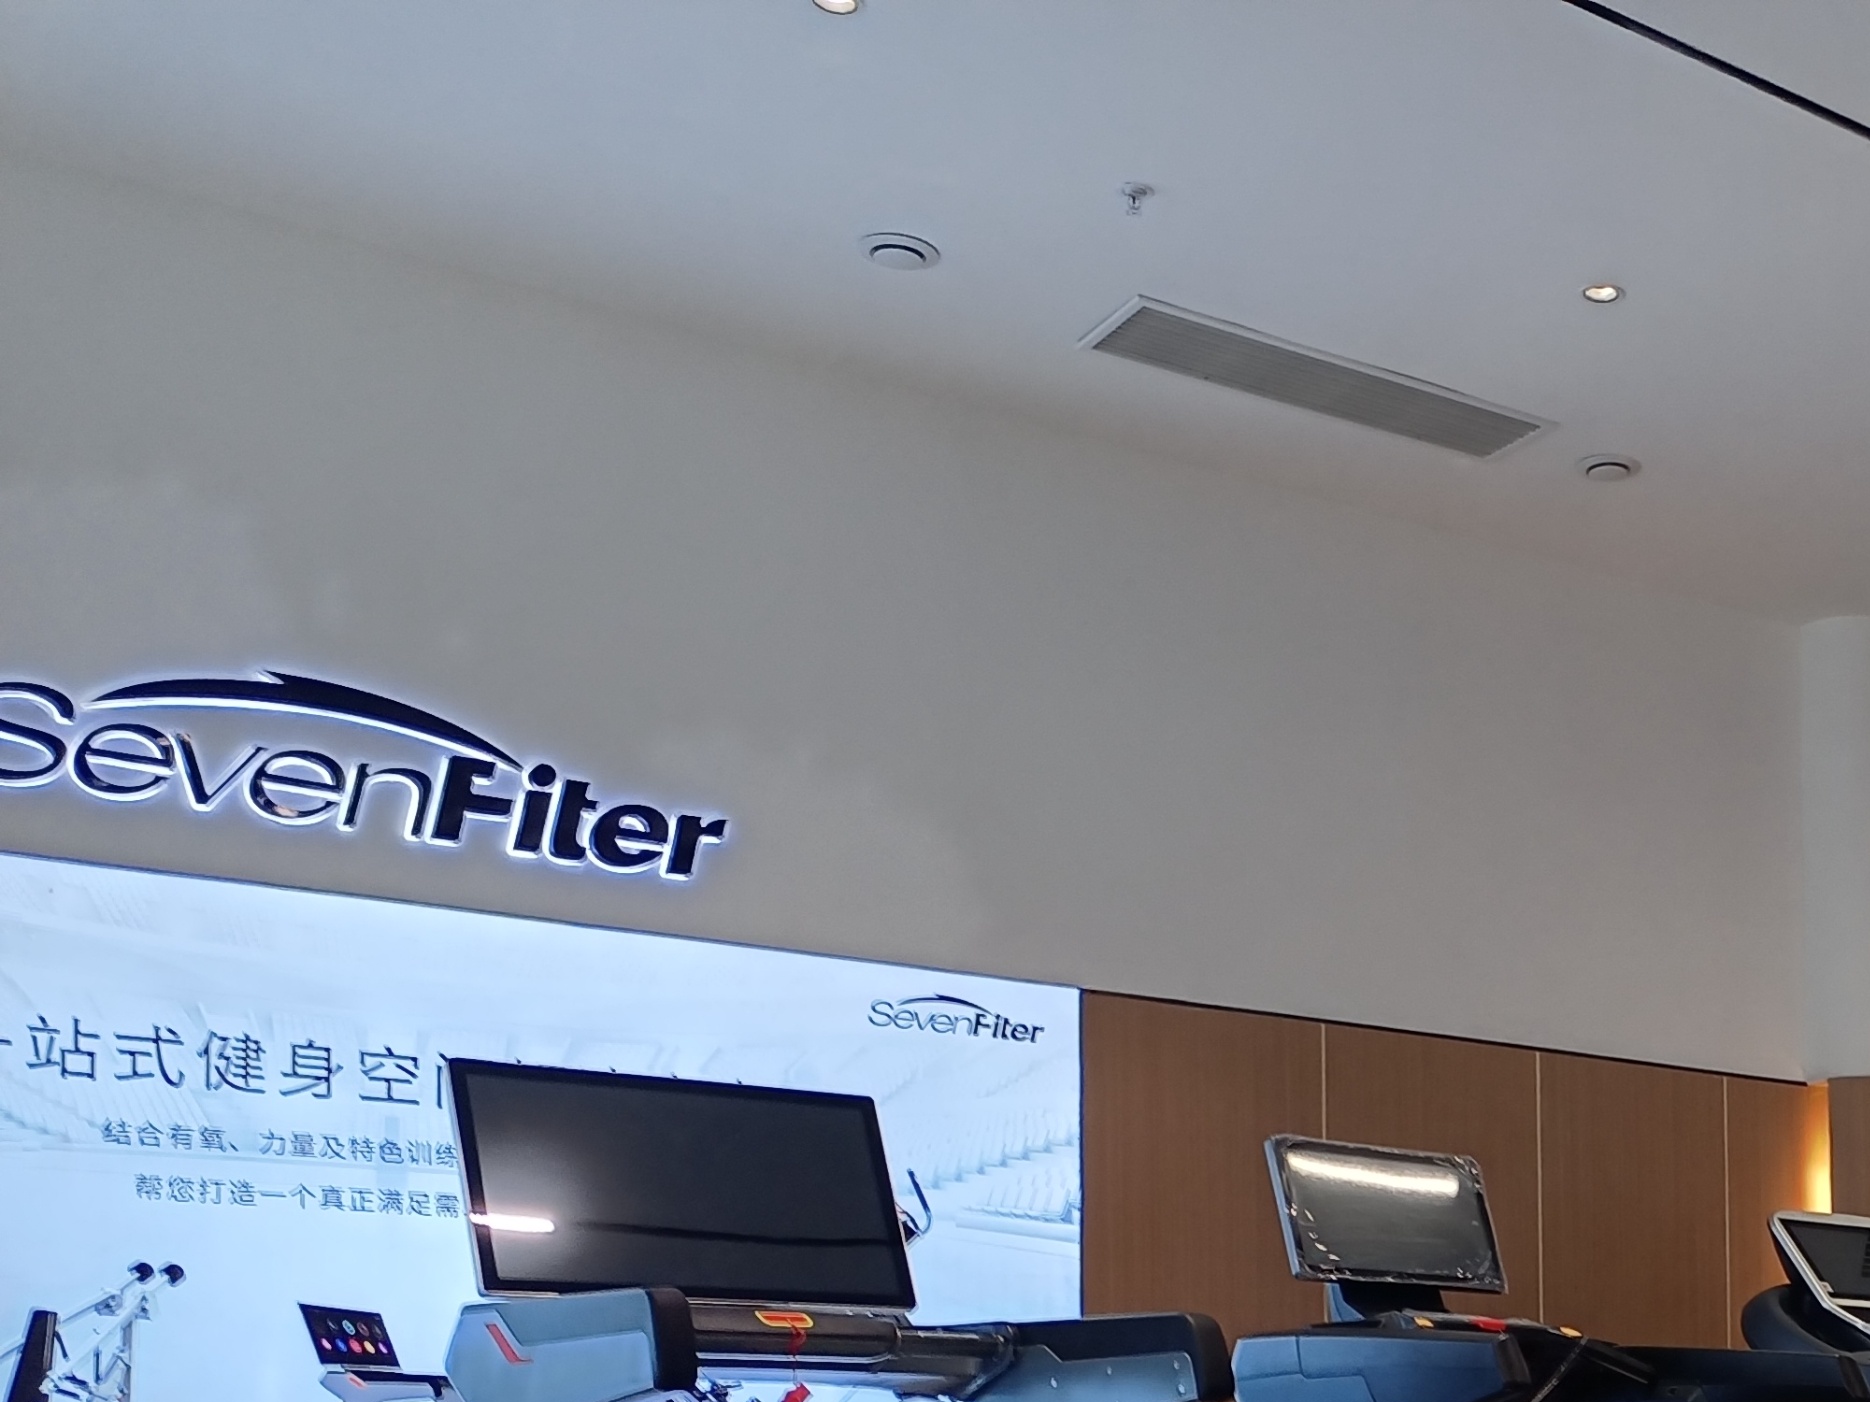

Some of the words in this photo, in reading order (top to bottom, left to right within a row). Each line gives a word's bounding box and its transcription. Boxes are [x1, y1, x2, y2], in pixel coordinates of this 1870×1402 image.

[0, 680, 727, 878] SevenFiter
[867, 997, 1044, 1043] SevenFiter
[0, 1013, 448, 1109] 站式健身空
[134, 1172, 467, 1218] 帮您打造一个真正满足需
